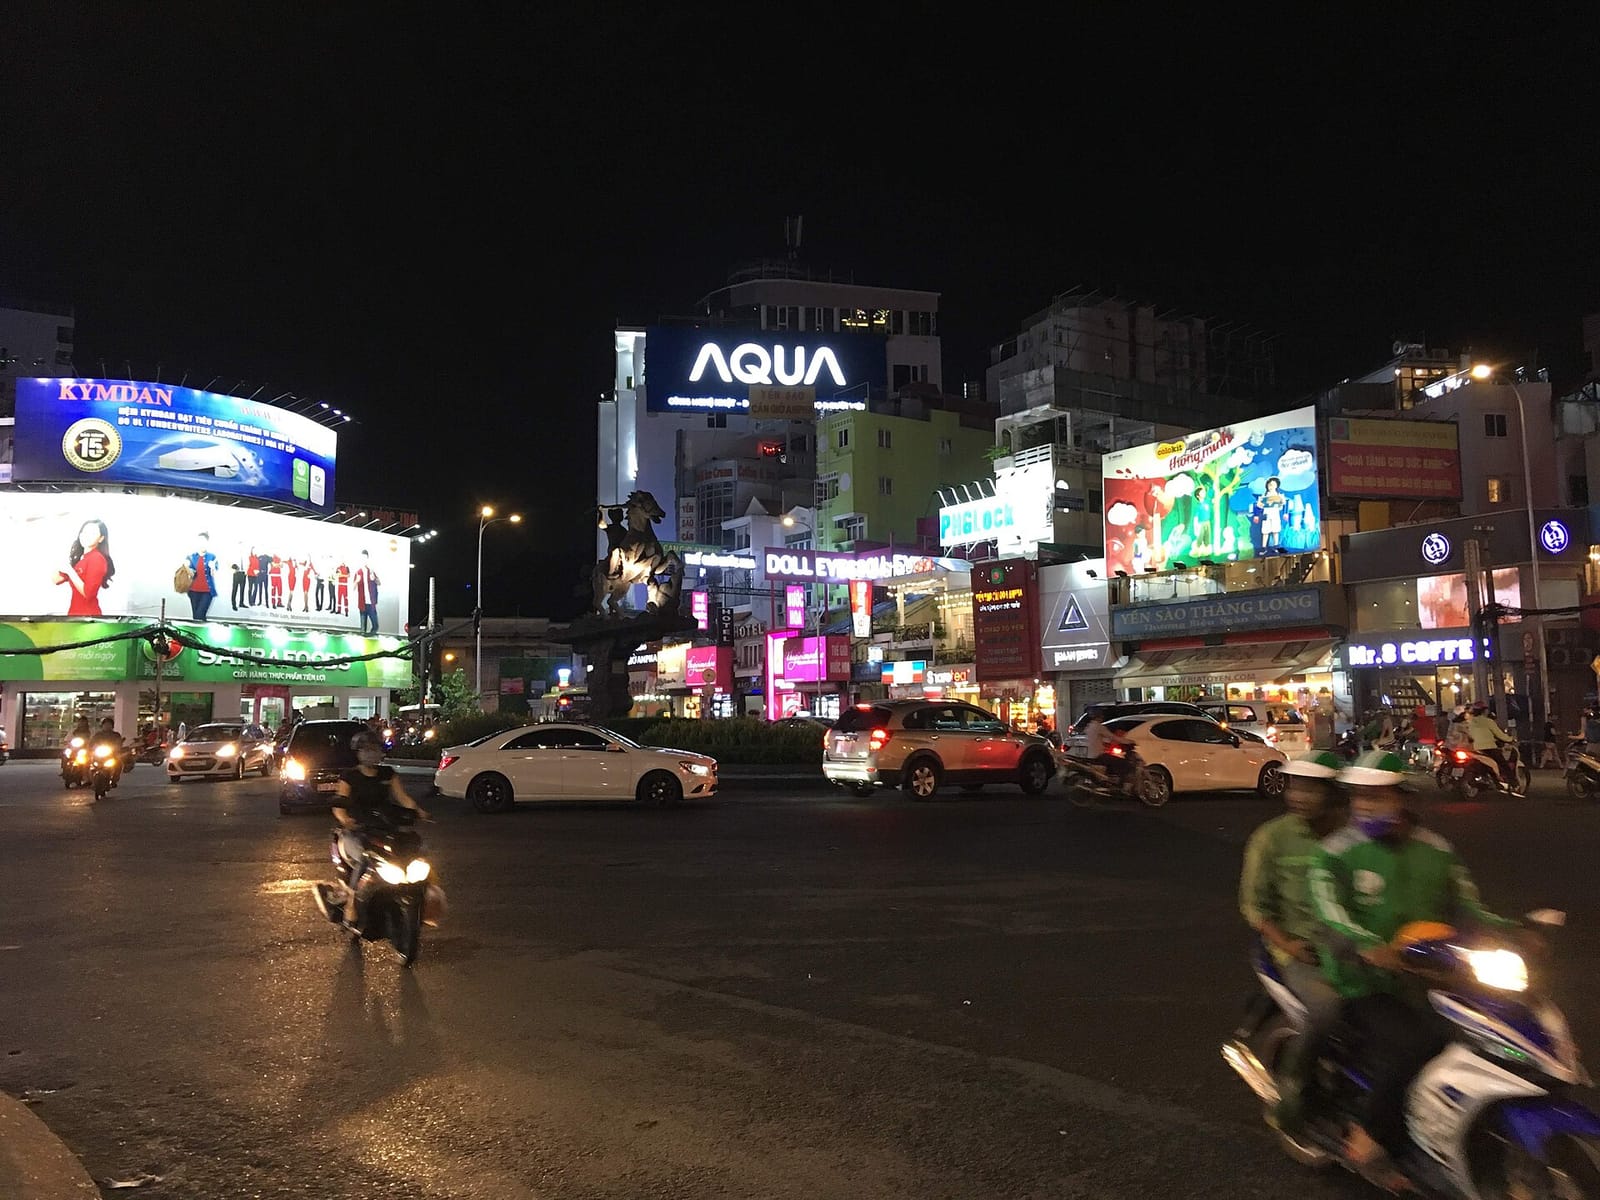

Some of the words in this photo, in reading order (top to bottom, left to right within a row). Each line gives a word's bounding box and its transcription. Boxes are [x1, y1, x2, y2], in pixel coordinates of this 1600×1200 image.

[688, 342, 847, 386] AQUA
[58, 382, 173, 407] KYMDAN
[79, 437, 105, 458] 15
[1201, 431, 1234, 459] minh
[766, 553, 813, 576] DOLL
[1120, 605, 1151, 626] YẾN
[1155, 607, 1187, 622] SÀO
[1190, 601, 1253, 619] THĂNG
[1258, 594, 1313, 612] LONG
[722, 609, 731, 642] HOTEL
[734, 623, 764, 638] HOTEL
[1401, 638, 1490, 662] COFFE
